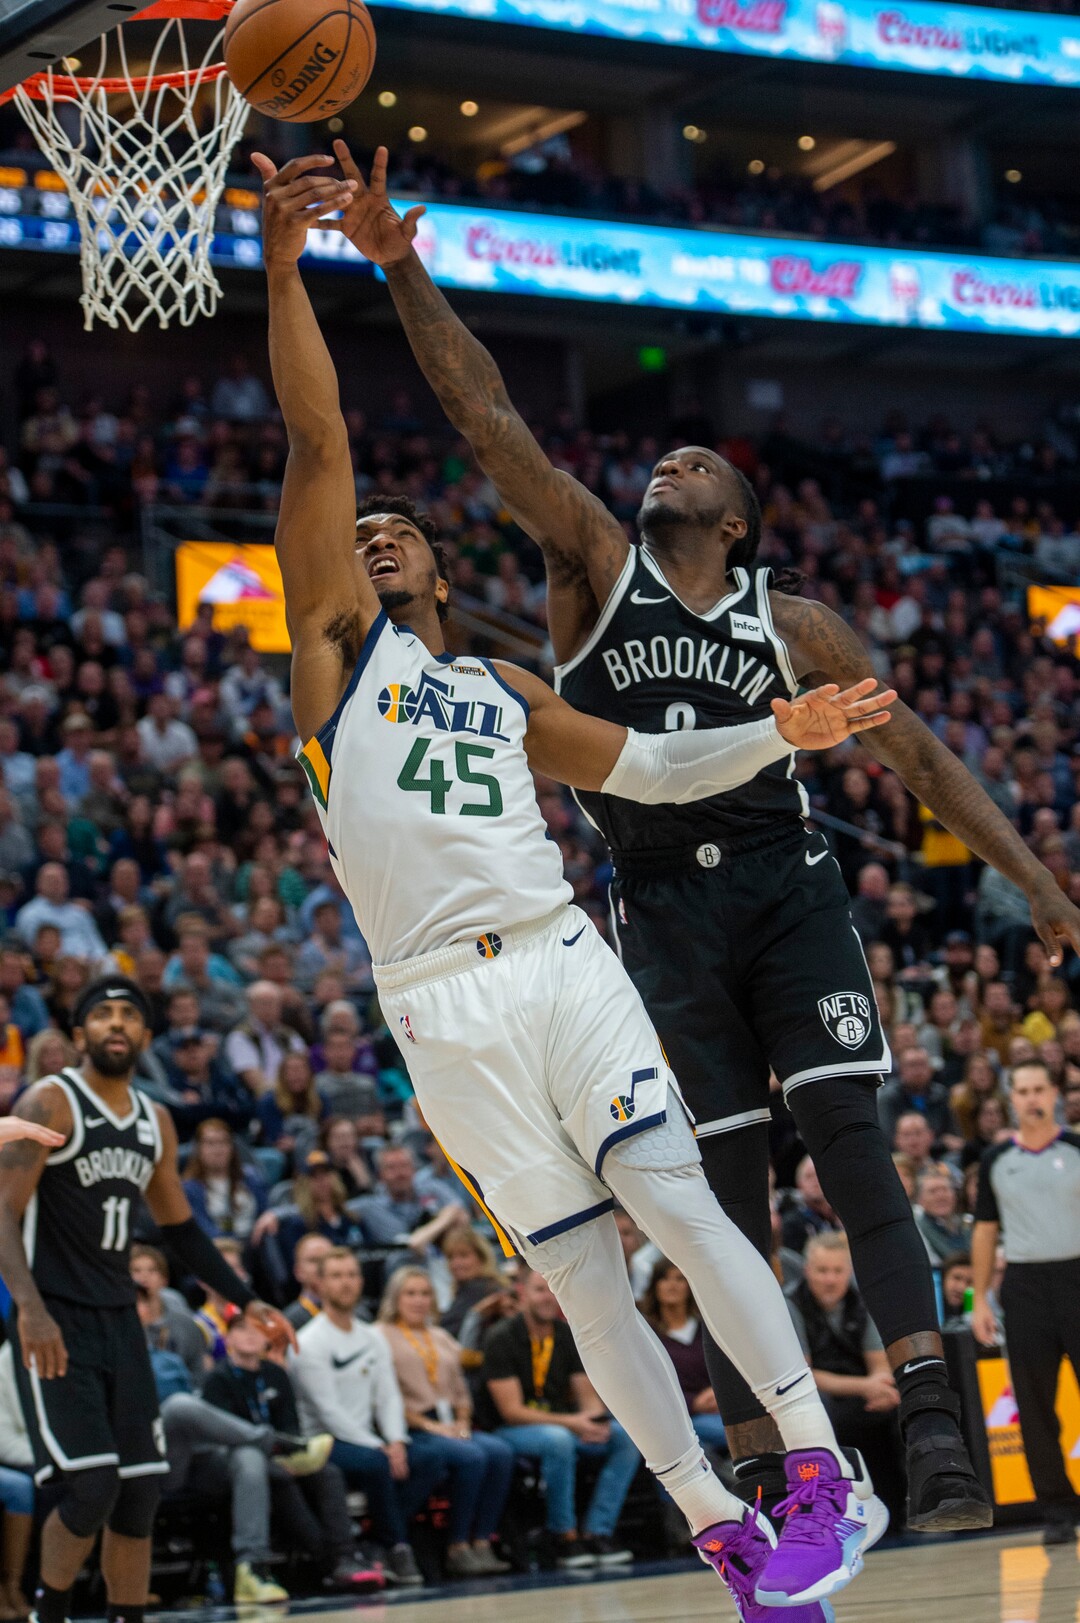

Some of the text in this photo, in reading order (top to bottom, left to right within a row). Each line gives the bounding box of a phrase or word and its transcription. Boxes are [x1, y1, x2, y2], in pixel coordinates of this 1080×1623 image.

[732, 619, 761, 633] infor
[601, 635, 776, 706] BROOKLYN
[396, 736, 504, 818] 45
[822, 994, 869, 1022] NETS
[101, 1196, 130, 1251] 11
